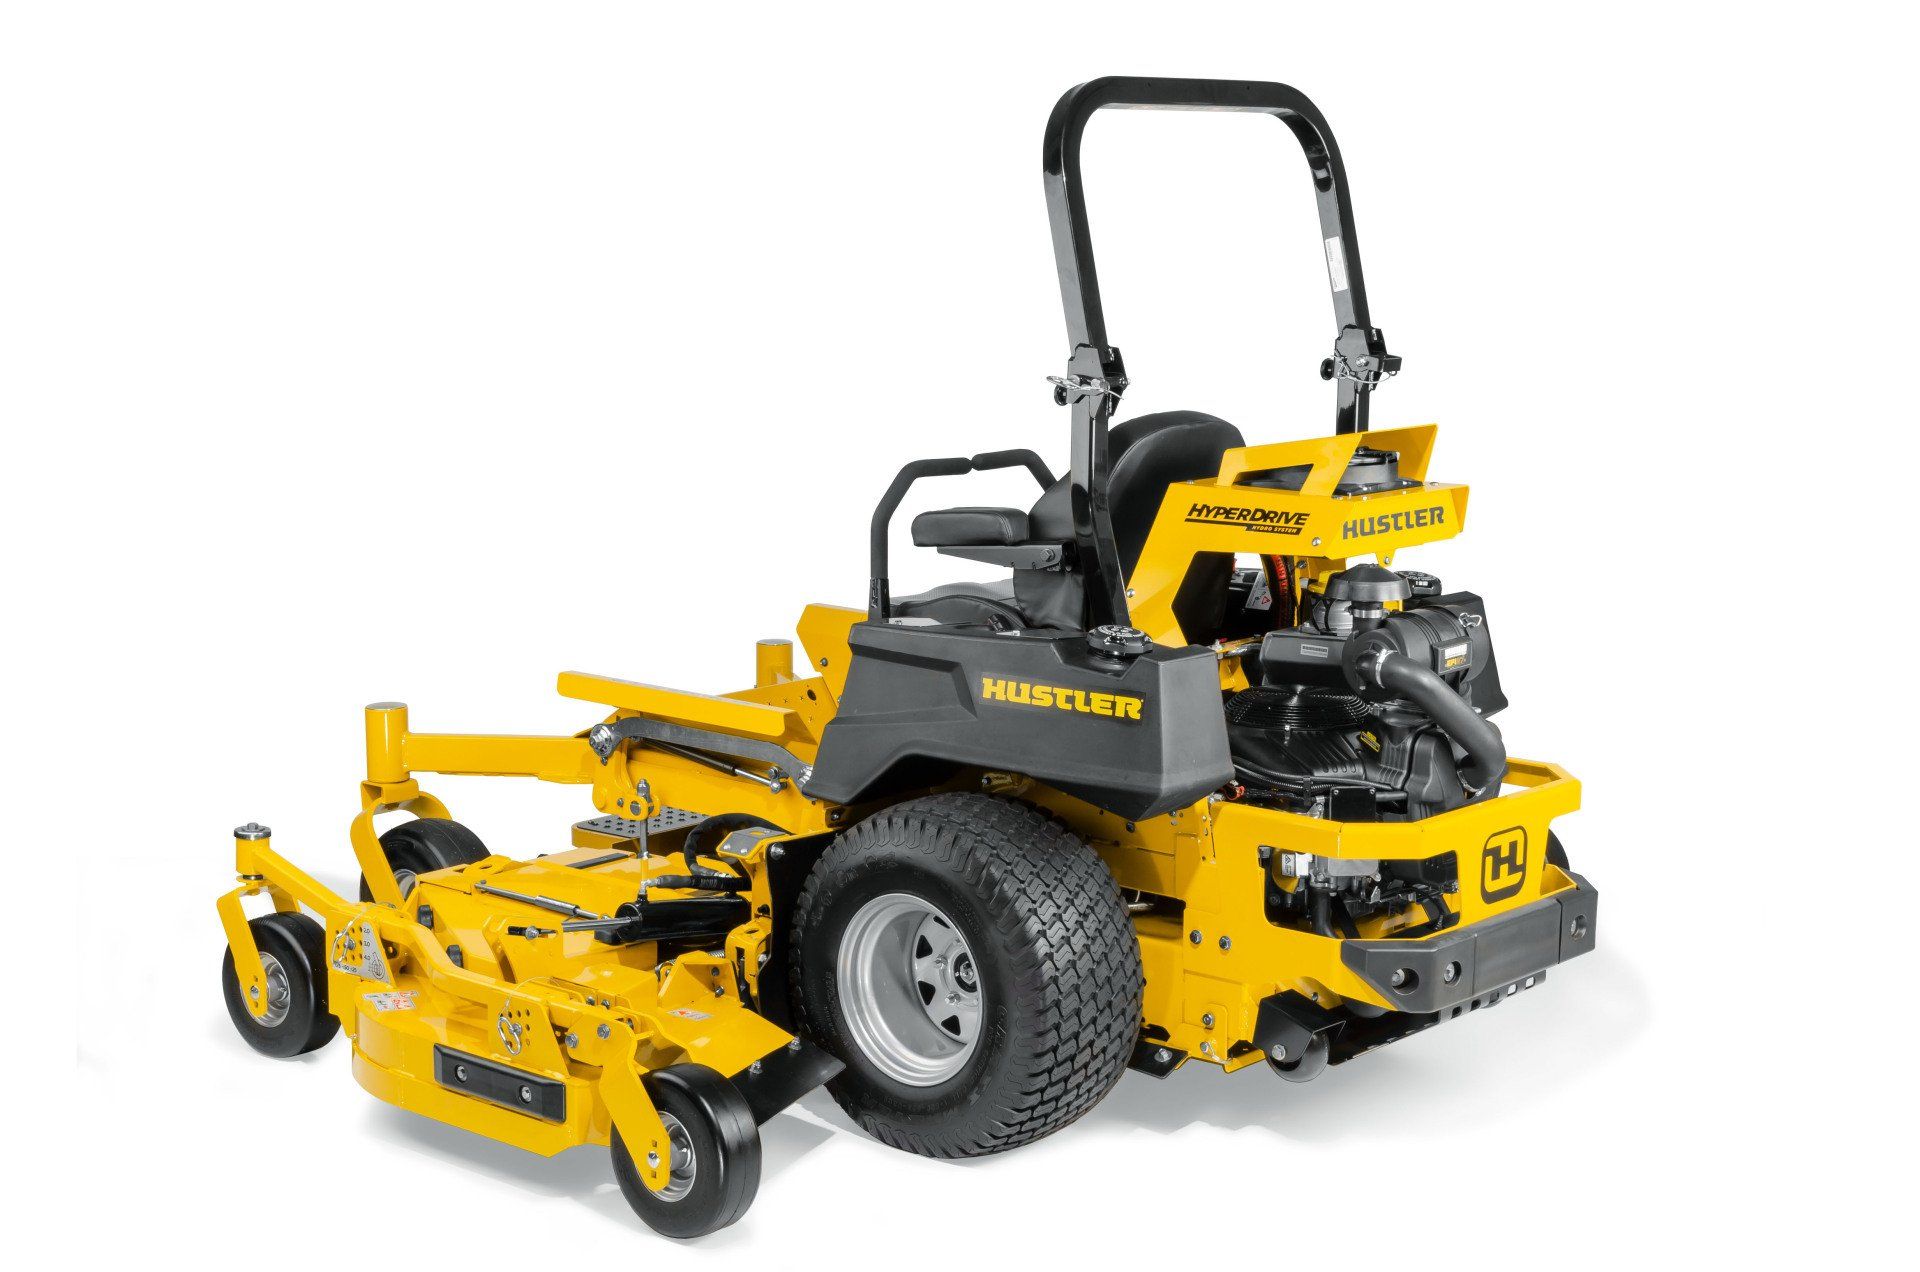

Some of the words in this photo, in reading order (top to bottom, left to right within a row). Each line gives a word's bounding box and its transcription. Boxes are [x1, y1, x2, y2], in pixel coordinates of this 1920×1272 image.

[1187, 503, 1310, 525] HYPERDRIVE
[1343, 506, 1444, 540] HUSTLER
[1273, 526, 1298, 534] SYSTEM
[982, 677, 1142, 720] HUSTLER
